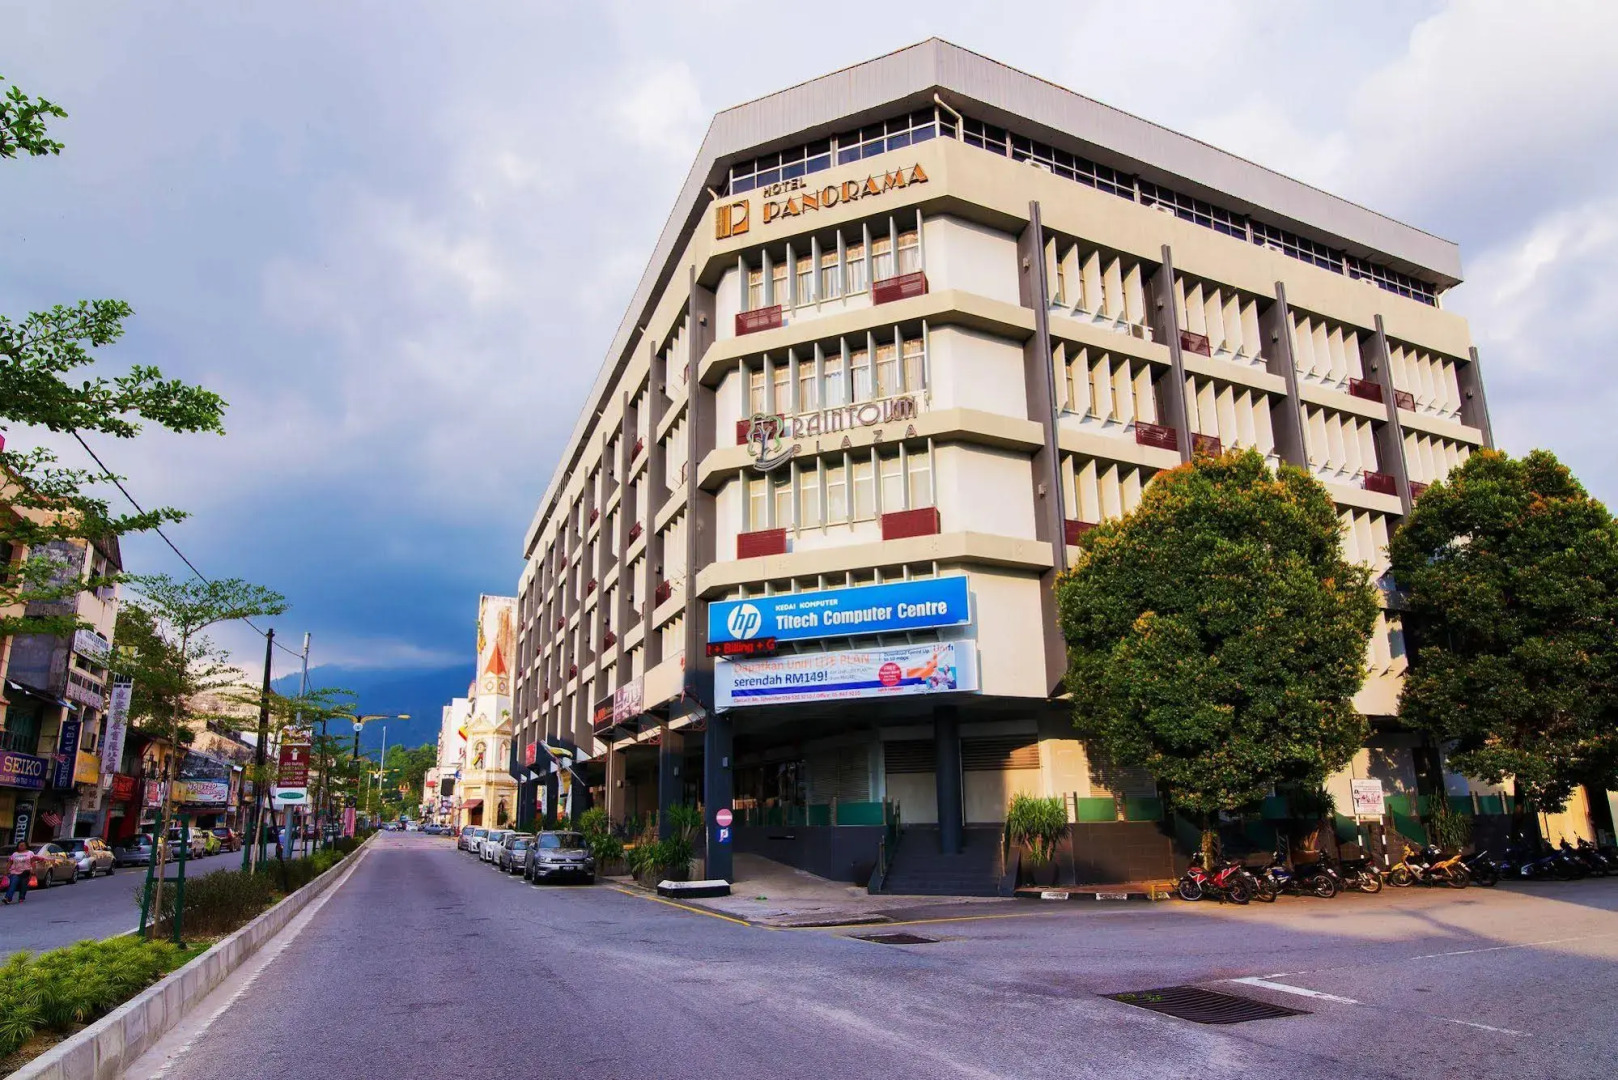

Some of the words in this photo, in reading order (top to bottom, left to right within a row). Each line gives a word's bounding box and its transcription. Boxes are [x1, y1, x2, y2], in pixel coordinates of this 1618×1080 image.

[763, 177, 807, 198] HOTEL
[763, 163, 929, 224] PANORAMA
[775, 603, 796, 611] KEDAI
[800, 599, 838, 609] KOMPUTER
[776, 612, 818, 630] Titech
[823, 606, 893, 625] Computer
[897, 601, 948, 618] Centre
[731, 603, 759, 639] hp
[724, 642, 755, 654] Billing
[734, 661, 784, 673] Dapatkan
[734, 675, 782, 687] serendah
[785, 671, 828, 684] RM149!
[65, 725, 76, 752] ALBA
[3, 755, 42, 776] SEIKO
[59, 756, 71, 787] SEIKO
